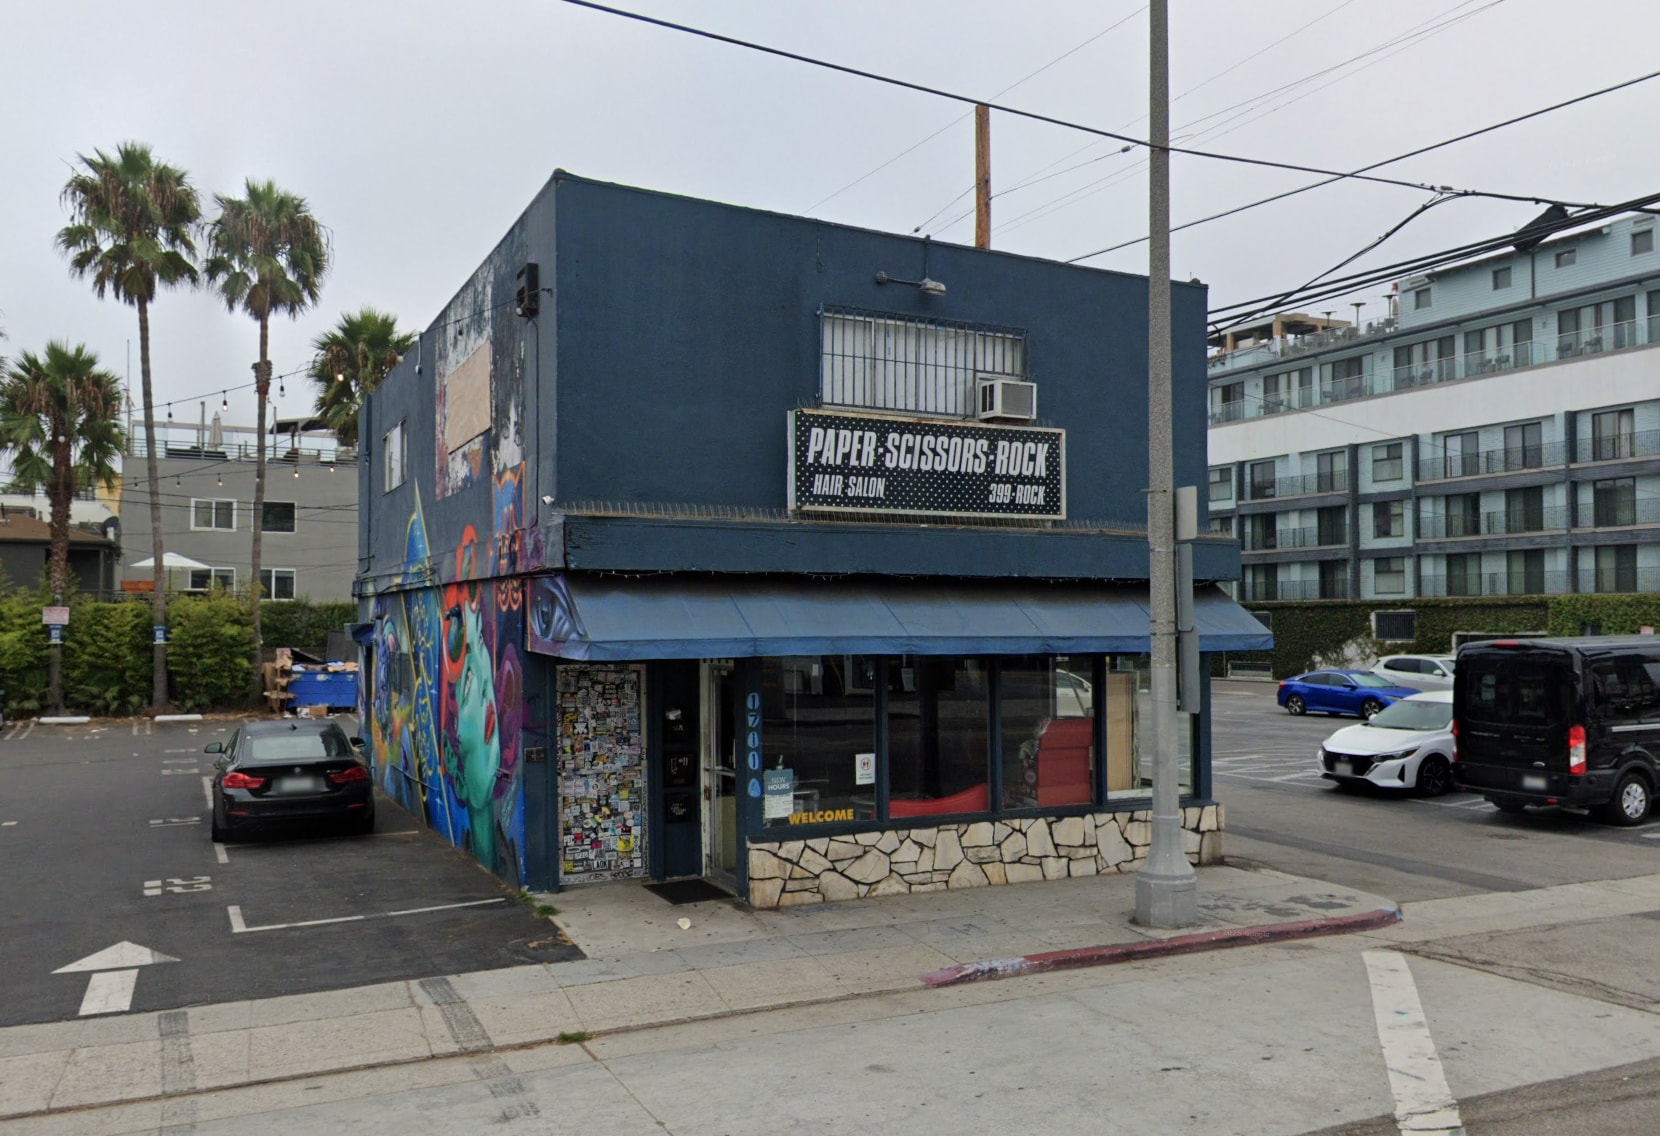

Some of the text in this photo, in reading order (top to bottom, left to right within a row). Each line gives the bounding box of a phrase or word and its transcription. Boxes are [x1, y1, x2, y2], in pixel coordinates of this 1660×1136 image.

[807, 427, 1049, 478] PAPER SCISSORS ROCK
[812, 474, 886, 498] HAIR SALON
[767, 783, 790, 791] HOURS
[788, 808, 854, 825] WELCOME
